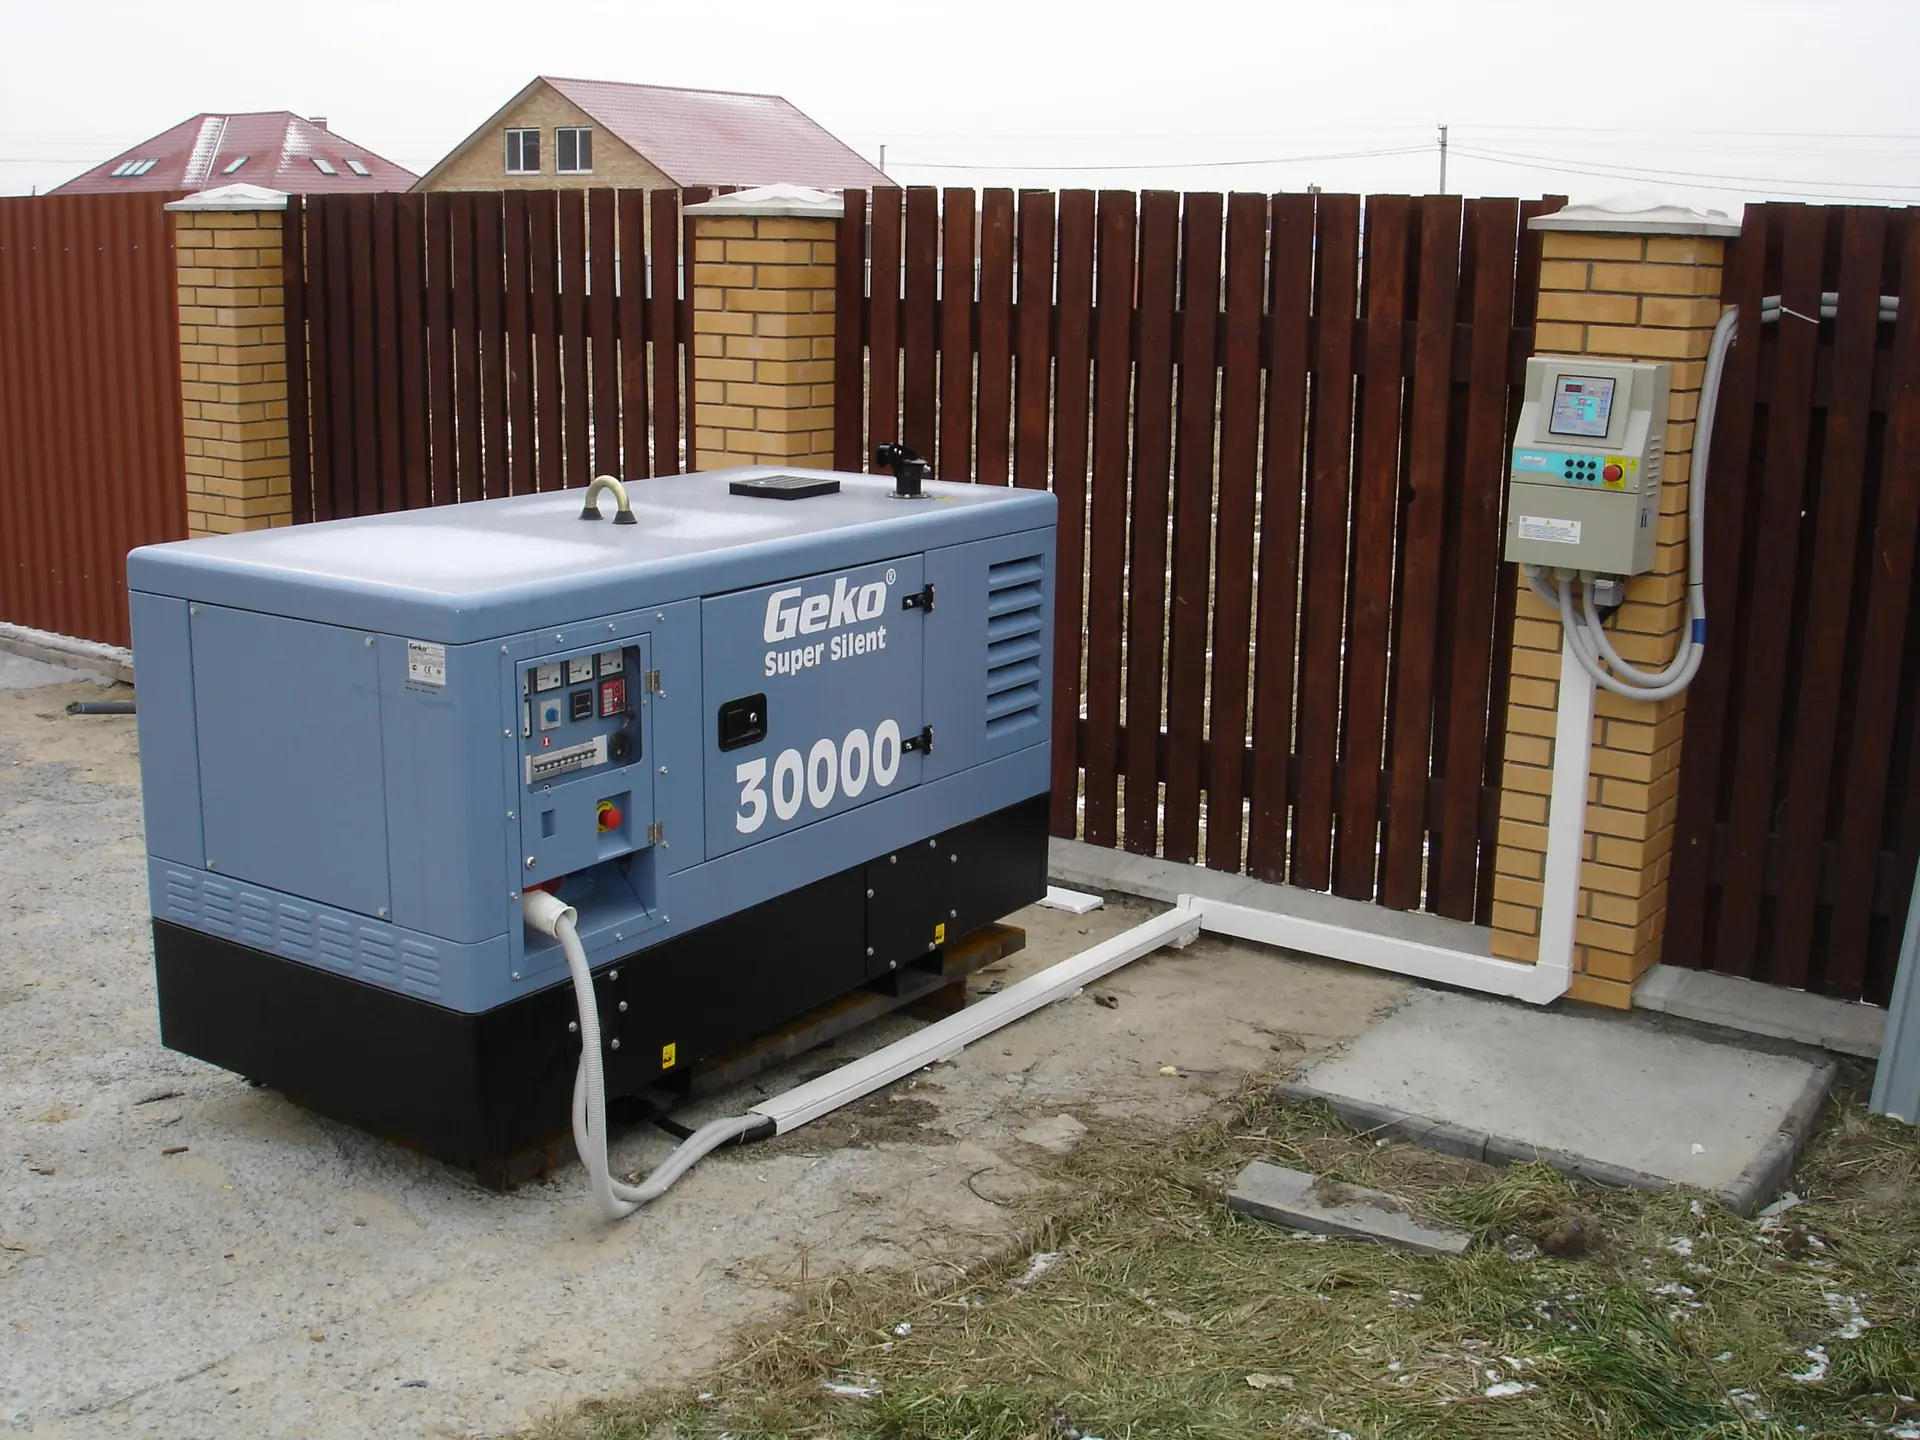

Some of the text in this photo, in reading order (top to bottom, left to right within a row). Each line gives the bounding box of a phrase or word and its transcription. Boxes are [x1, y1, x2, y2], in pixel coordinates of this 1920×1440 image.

[765, 625, 887, 677] Super Silent
[736, 719, 901, 834] 30000
